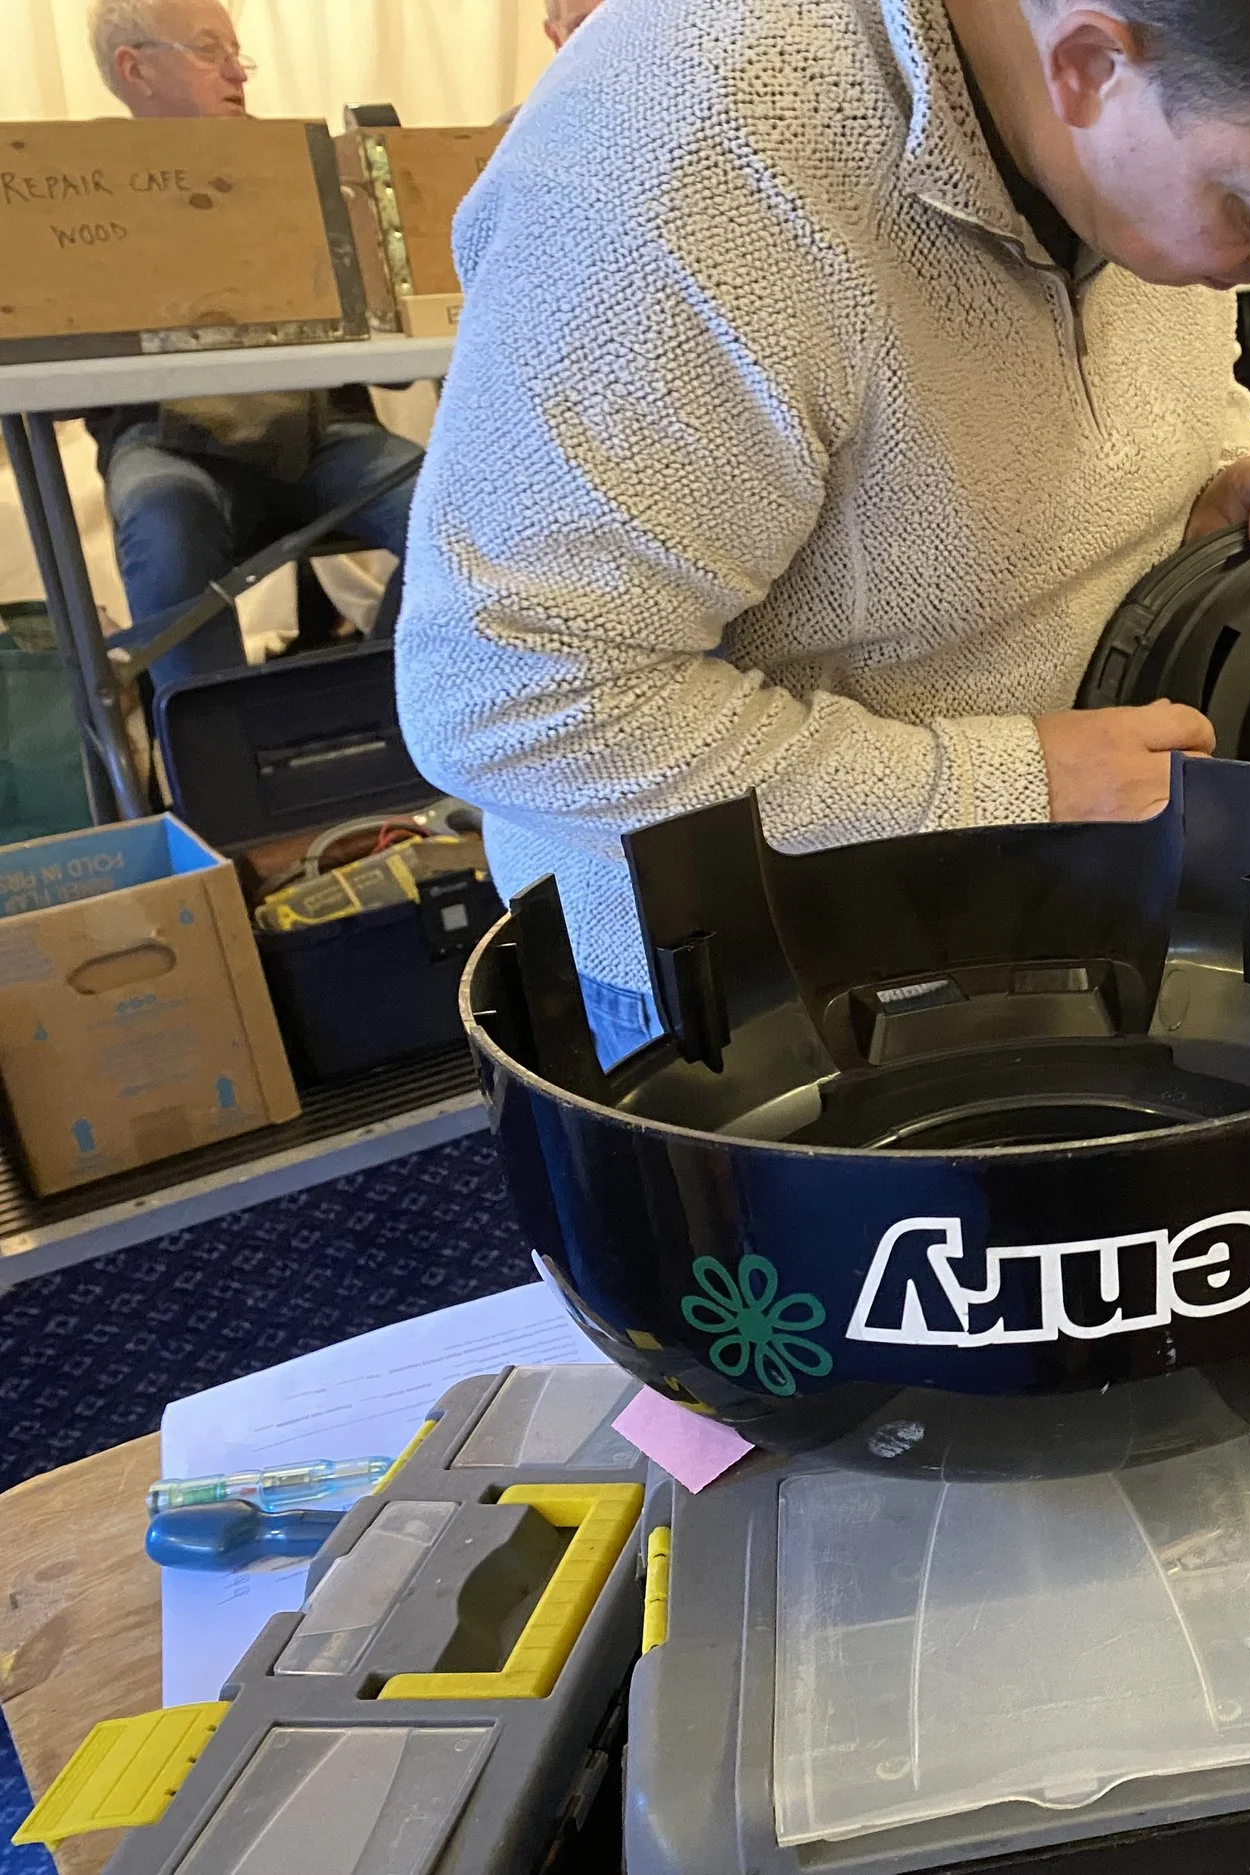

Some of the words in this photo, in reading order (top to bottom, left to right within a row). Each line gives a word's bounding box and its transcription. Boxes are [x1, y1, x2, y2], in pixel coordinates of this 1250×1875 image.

[1, 168, 114, 204] REPAIR
[128, 168, 192, 192] CAFE
[50, 222, 128, 249] WOOD
[66, 851, 125, 878] FOLD
